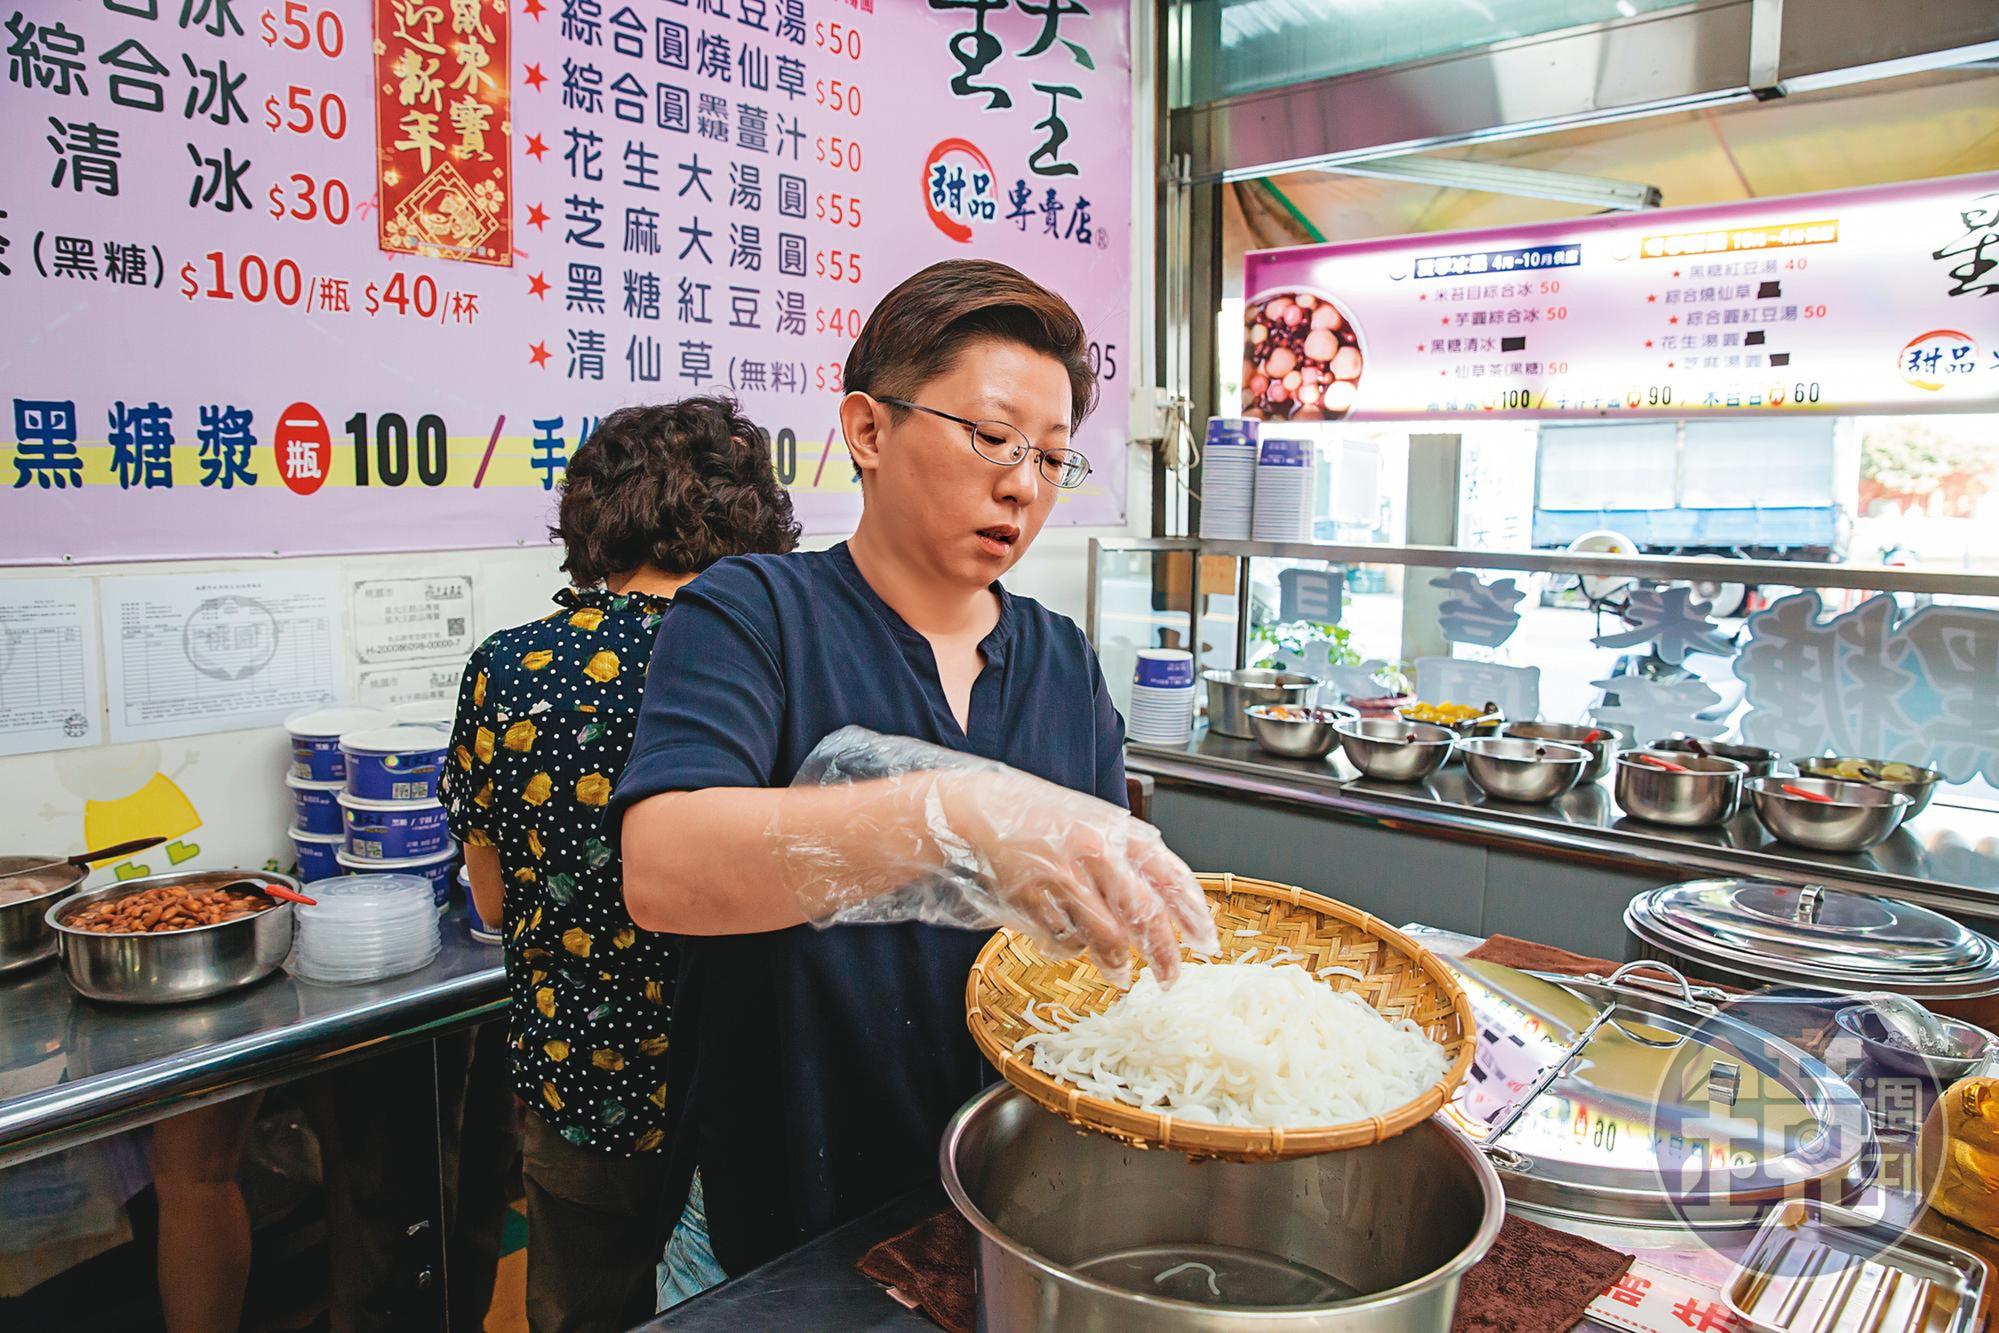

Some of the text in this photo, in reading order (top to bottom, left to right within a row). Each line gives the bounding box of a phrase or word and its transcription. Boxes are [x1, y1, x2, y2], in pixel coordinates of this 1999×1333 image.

[260, 2, 345, 58] $50
[815, 21, 861, 60] $50
[4, 11, 348, 141] 綜合冰 $50
[561, 0, 861, 116] 綜合圓燒仙草 $50
[816, 136, 861, 172] $50
[563, 127, 862, 228] 花生大湯圓 $55
[269, 173, 350, 225] $30
[564, 194, 862, 284] 芝麻大湯圓 $55
[1785, 259, 1807, 271] 40
[565, 262, 861, 339] 黑糖紅豆湯 $40
[1540, 281, 1560, 295] 50
[1547, 306, 1568, 321] 50
[1804, 304, 1827, 319] 50
[816, 362, 843, 393] $3
[1549, 362, 1568, 375] 50
[1502, 389, 1530, 408] 100
[1649, 386, 1671, 406] 90
[1795, 382, 1820, 403] 60
[13, 398, 258, 489] 黑糖漿
[285, 419, 321, 478] 一瓶
[345, 412, 447, 487] 100
[531, 416, 600, 491] 手
